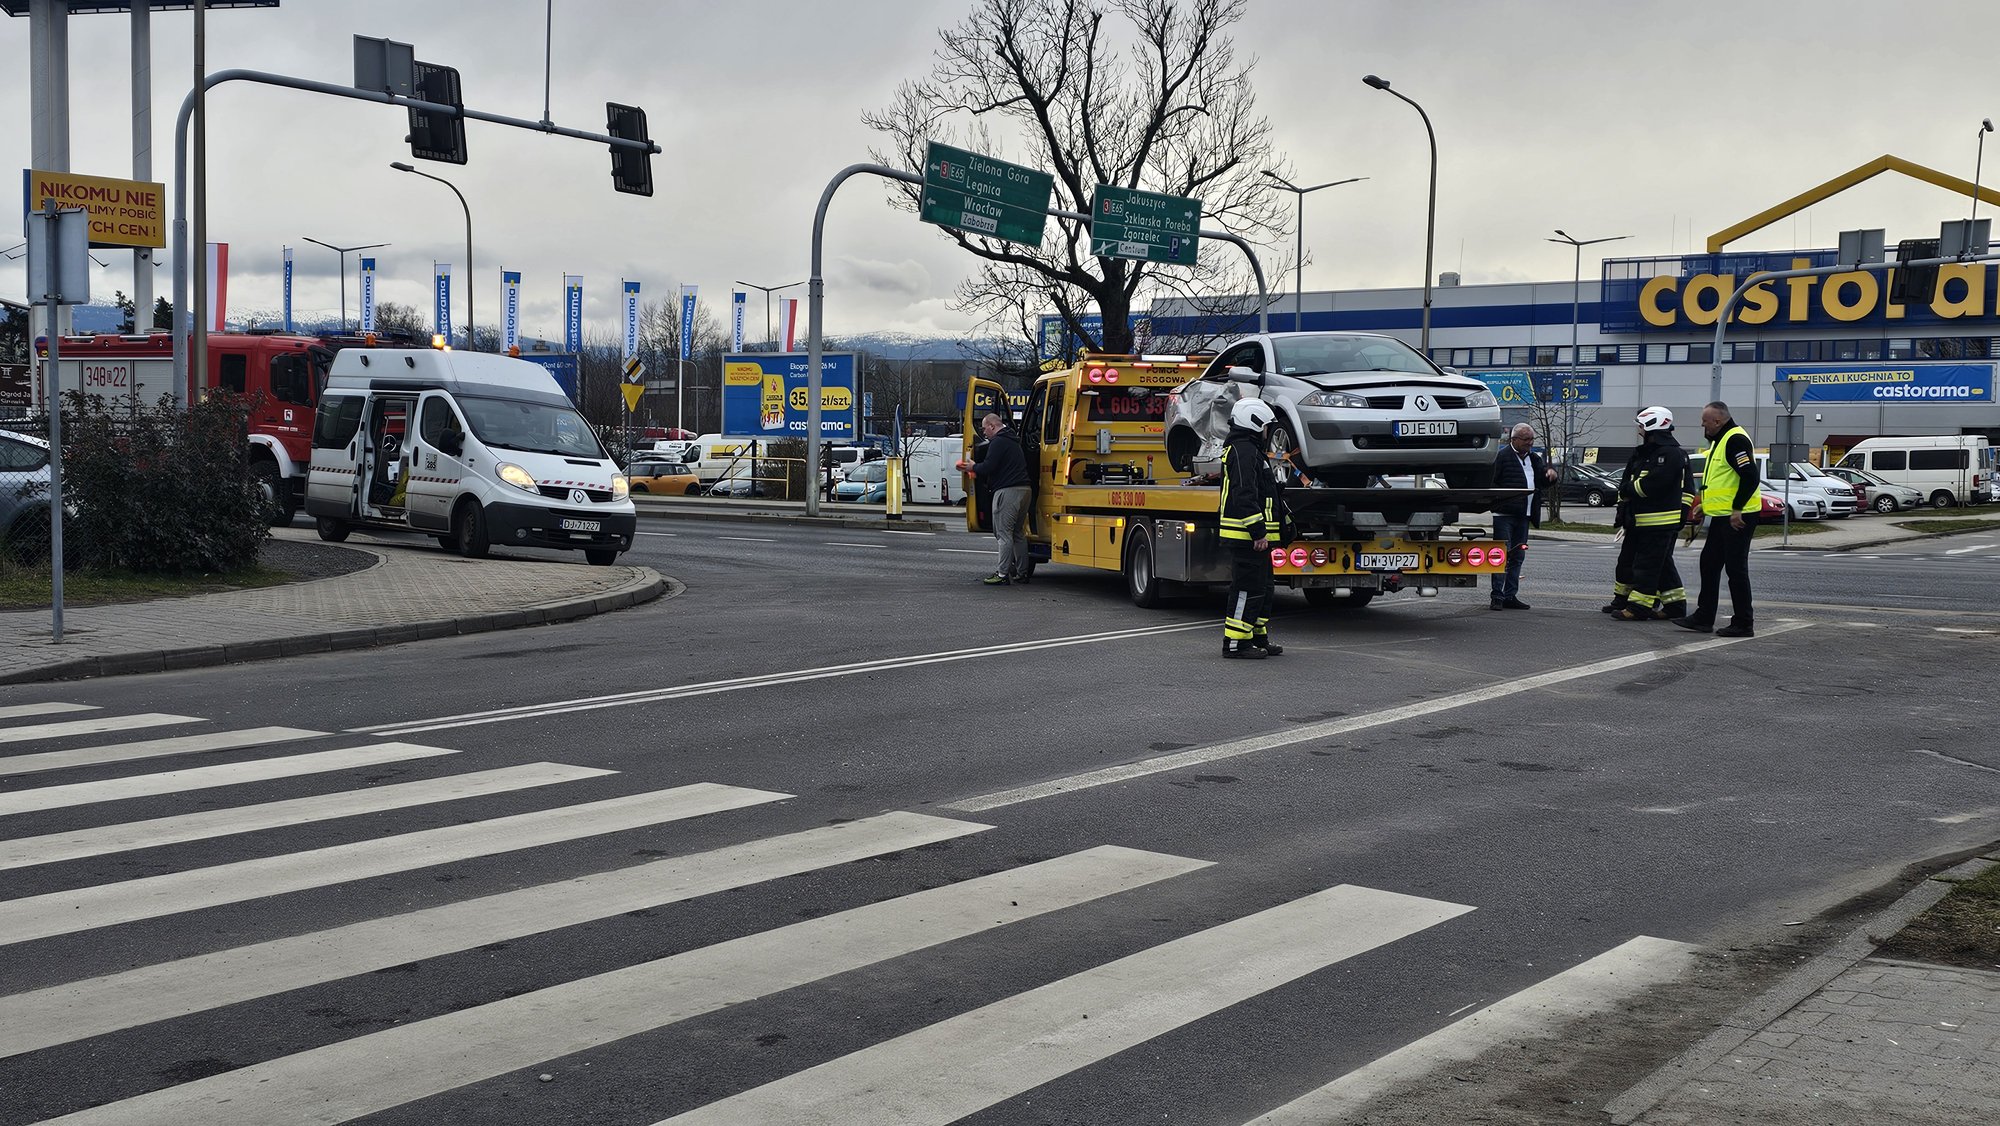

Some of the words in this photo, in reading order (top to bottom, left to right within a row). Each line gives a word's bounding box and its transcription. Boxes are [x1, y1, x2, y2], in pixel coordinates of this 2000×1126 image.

[942, 163, 948, 176] 3
[950, 166, 965, 180] E65
[969, 156, 1002, 177] Zielona
[1007, 166, 1029, 184] Góra
[966, 175, 1000, 197] Legnica
[40, 181, 120, 204] NIKOMU
[125, 189, 156, 208] NIE
[964, 196, 1003, 218] Wrocław
[1104, 201, 1109, 212] 3
[1112, 203, 1123, 214] E65
[1126, 192, 1166, 211] Jakuszyce
[119, 207, 156, 220] POBIĆ
[1124, 211, 1161, 228] Szklarska
[118, 223, 149, 237] CEN
[1123, 226, 1160, 243] Zgorzelec
[1120, 242, 1147, 255] Centrum
[571, 291, 579, 352] castorama
[684, 300, 693, 357] castorama
[1140, 376, 1186, 384] DROGOWA
[1847, 373, 1894, 381] KUCHNIA
[1896, 371, 1911, 380] TO
[0, 390, 22, 399] Ogród
[1873, 384, 1970, 398] castorama
[1111, 396, 1140, 415] 605
[1145, 396, 1166, 416] 33
[1400, 423, 1426, 435] DJE
[1429, 423, 1455, 434] 01L7
[1112, 492, 1121, 505] 605
[564, 520, 575, 529] DJ
[577, 521, 600, 531] 71227
[1363, 556, 1377, 567] DW
[1381, 556, 1415, 567] 3VP27
